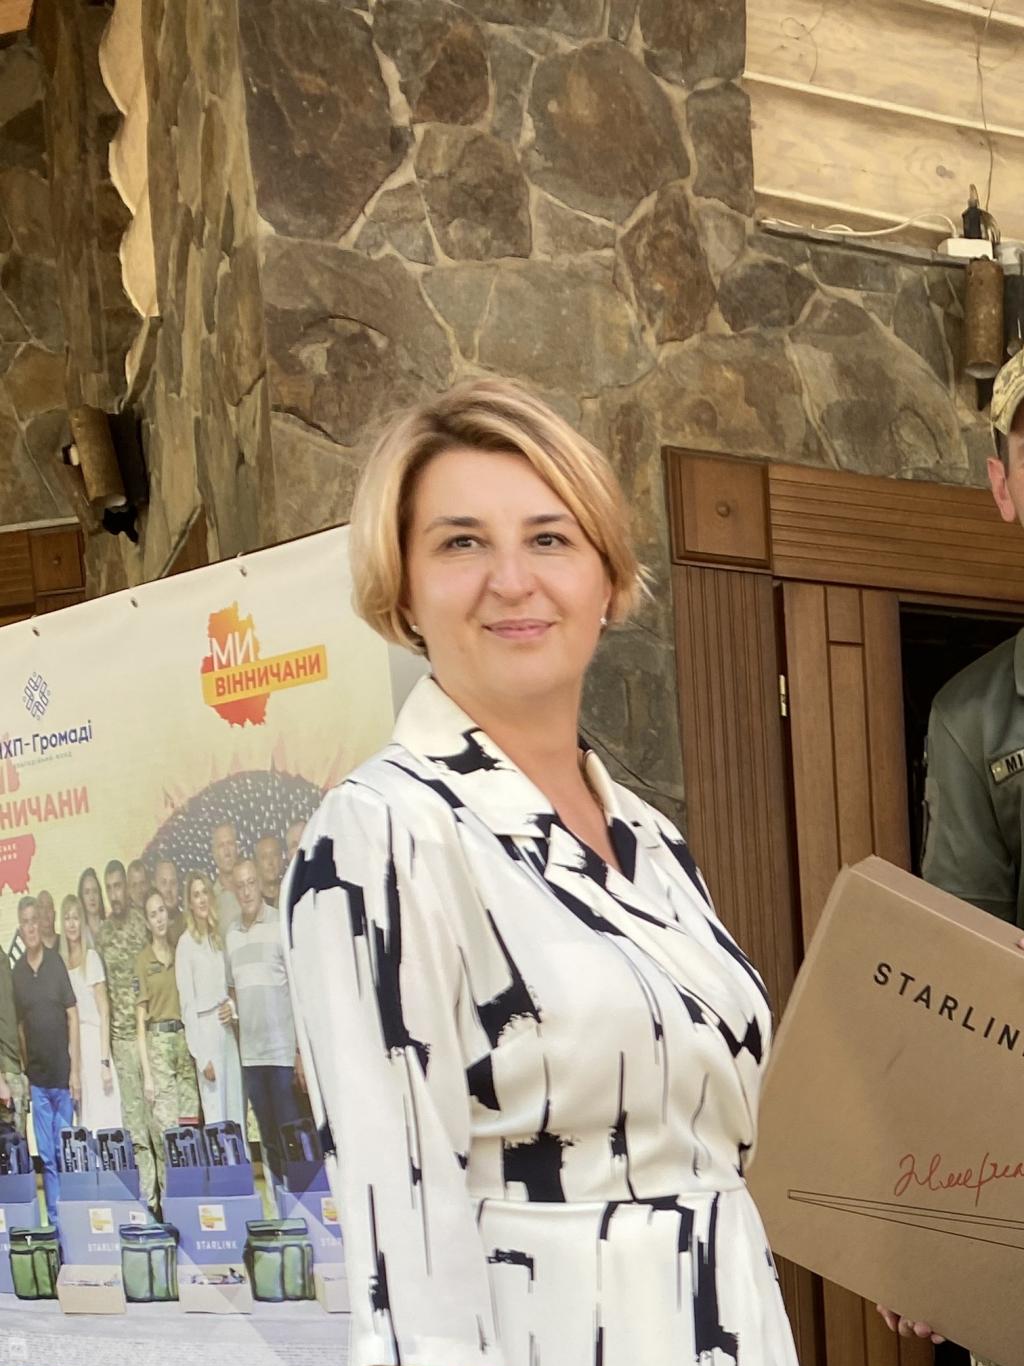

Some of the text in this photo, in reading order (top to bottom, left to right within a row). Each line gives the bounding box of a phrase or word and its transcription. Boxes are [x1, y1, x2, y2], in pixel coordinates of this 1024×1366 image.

[209, 627, 254, 671] МИ
[215, 653, 320, 697] ВІННИЧАНИ
[0, 719, 93, 760] ХП-Громаді
